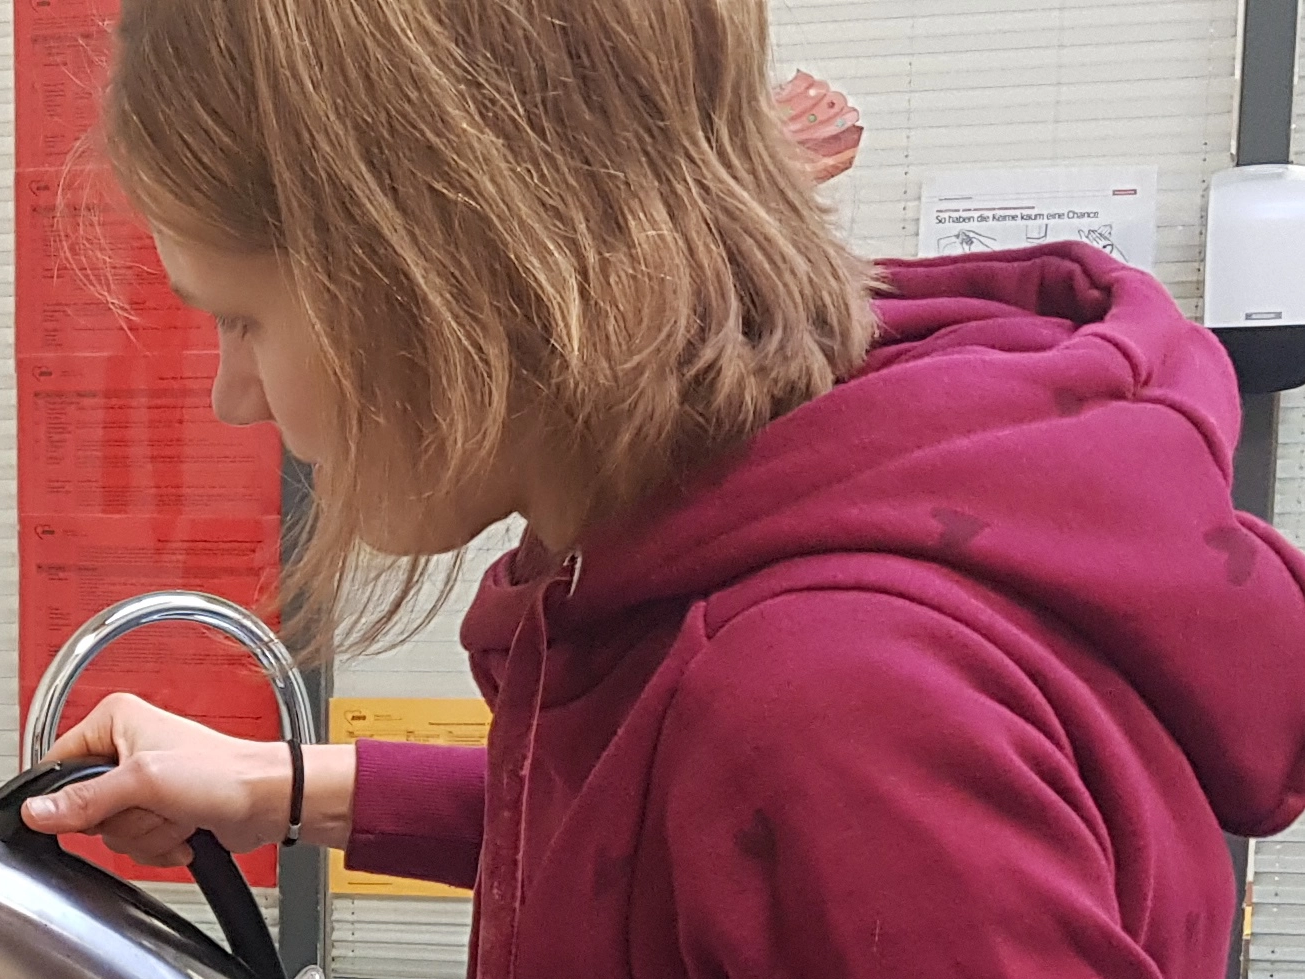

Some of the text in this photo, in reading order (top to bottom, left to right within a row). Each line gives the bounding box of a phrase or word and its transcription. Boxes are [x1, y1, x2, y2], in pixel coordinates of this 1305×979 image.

[935, 214, 946, 224] So
[948, 215, 975, 223] haben
[977, 213, 990, 222] die
[1020, 212, 1045, 220] kaum
[1046, 212, 1065, 220] eine
